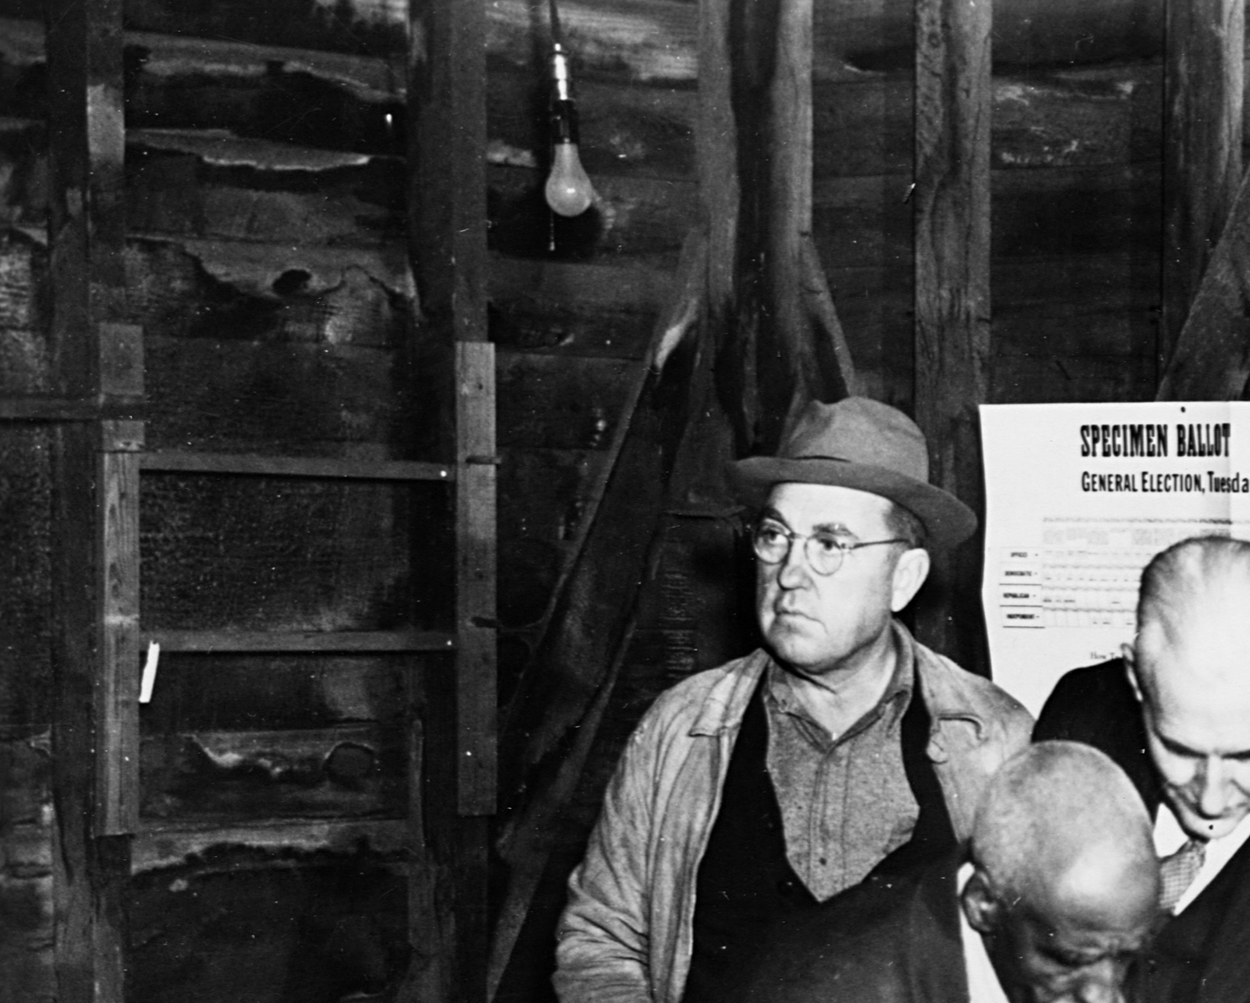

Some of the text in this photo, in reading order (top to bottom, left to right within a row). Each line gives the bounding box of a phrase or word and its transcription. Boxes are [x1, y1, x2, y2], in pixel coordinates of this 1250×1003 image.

[1080, 424, 1168, 457] SPECIMEN
[1176, 423, 1231, 457] BALLOT
[1081, 471, 1138, 492] GENERAL
[1141, 471, 1206, 495] ELECTION,
